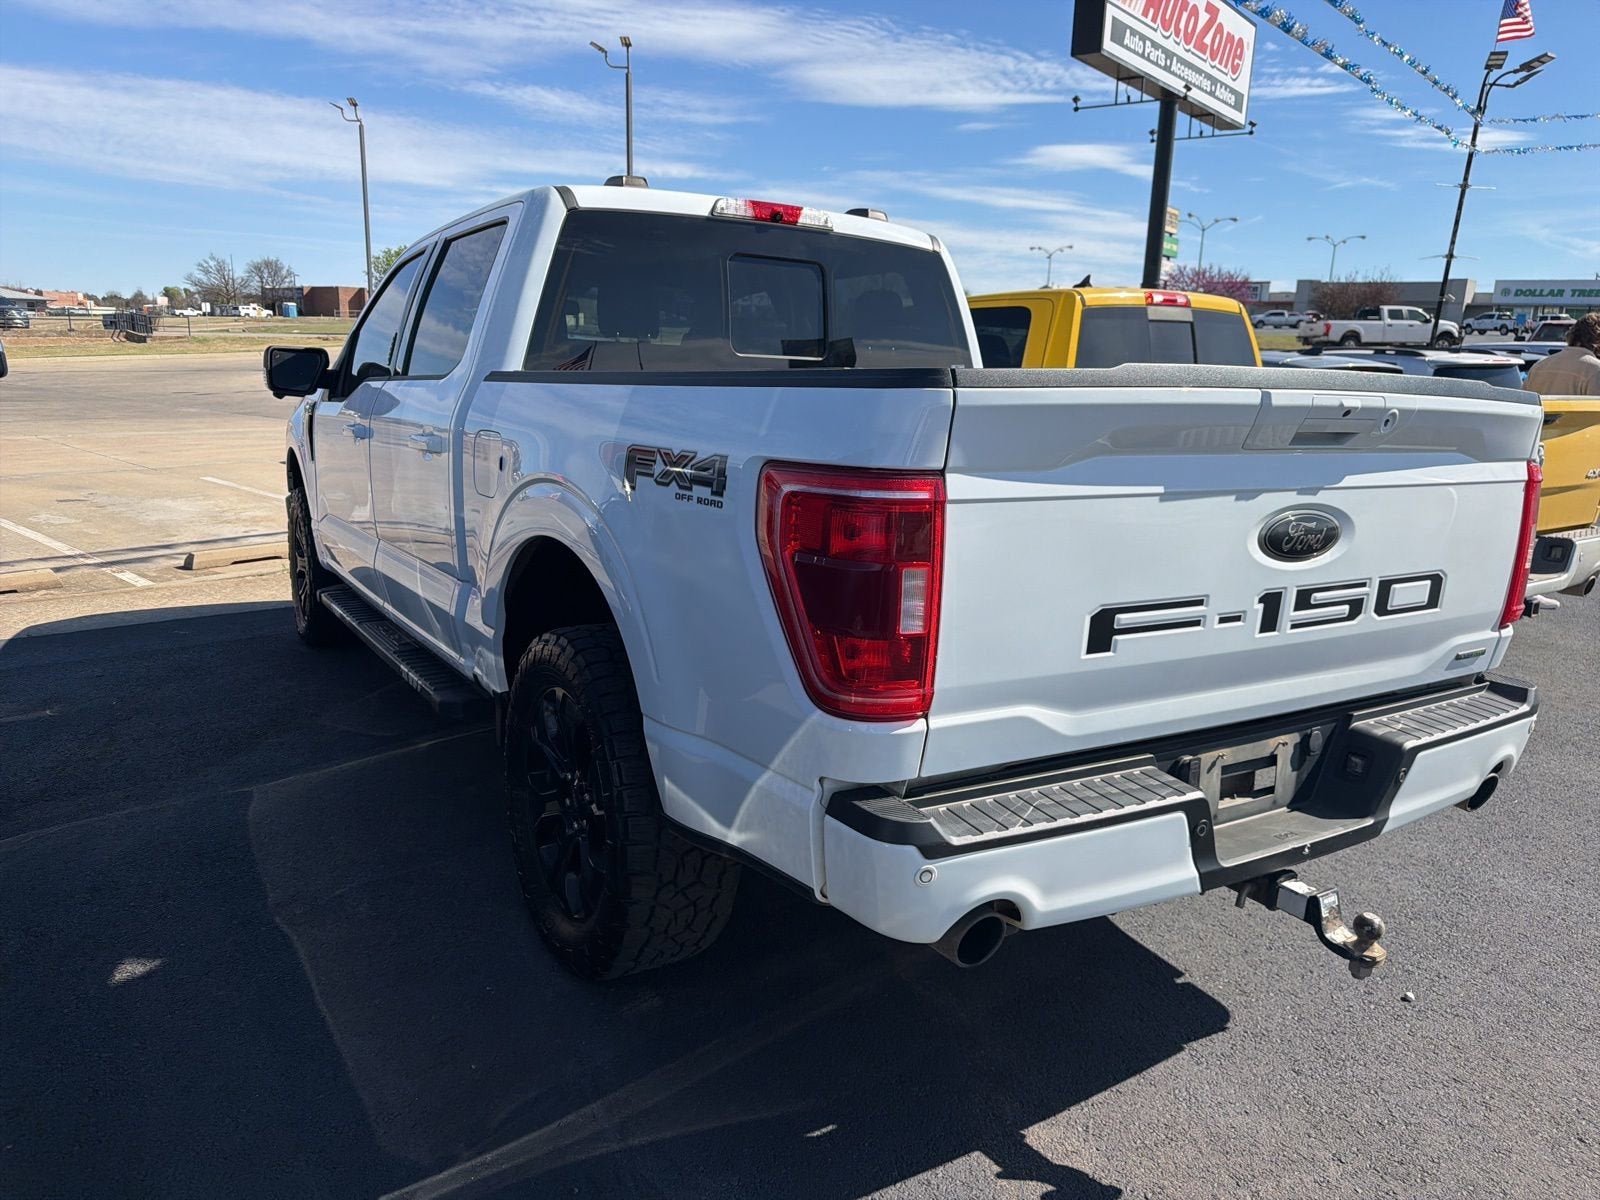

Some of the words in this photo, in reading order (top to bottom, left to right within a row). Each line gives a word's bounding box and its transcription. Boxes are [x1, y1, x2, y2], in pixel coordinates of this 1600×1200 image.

[1123, 28, 1144, 54] Auto
[1144, 40, 1166, 67] Parts
[1170, 56, 1211, 92] Accessories
[1215, 82, 1236, 106] Advice
[1513, 288, 1565, 297] DOLLAR
[623, 443, 729, 498] FX4
[674, 492, 694, 503] OFF
[696, 496, 724, 509] ROAD
[1281, 521, 1327, 551] Ford
[1082, 570, 1446, 658] F-150
